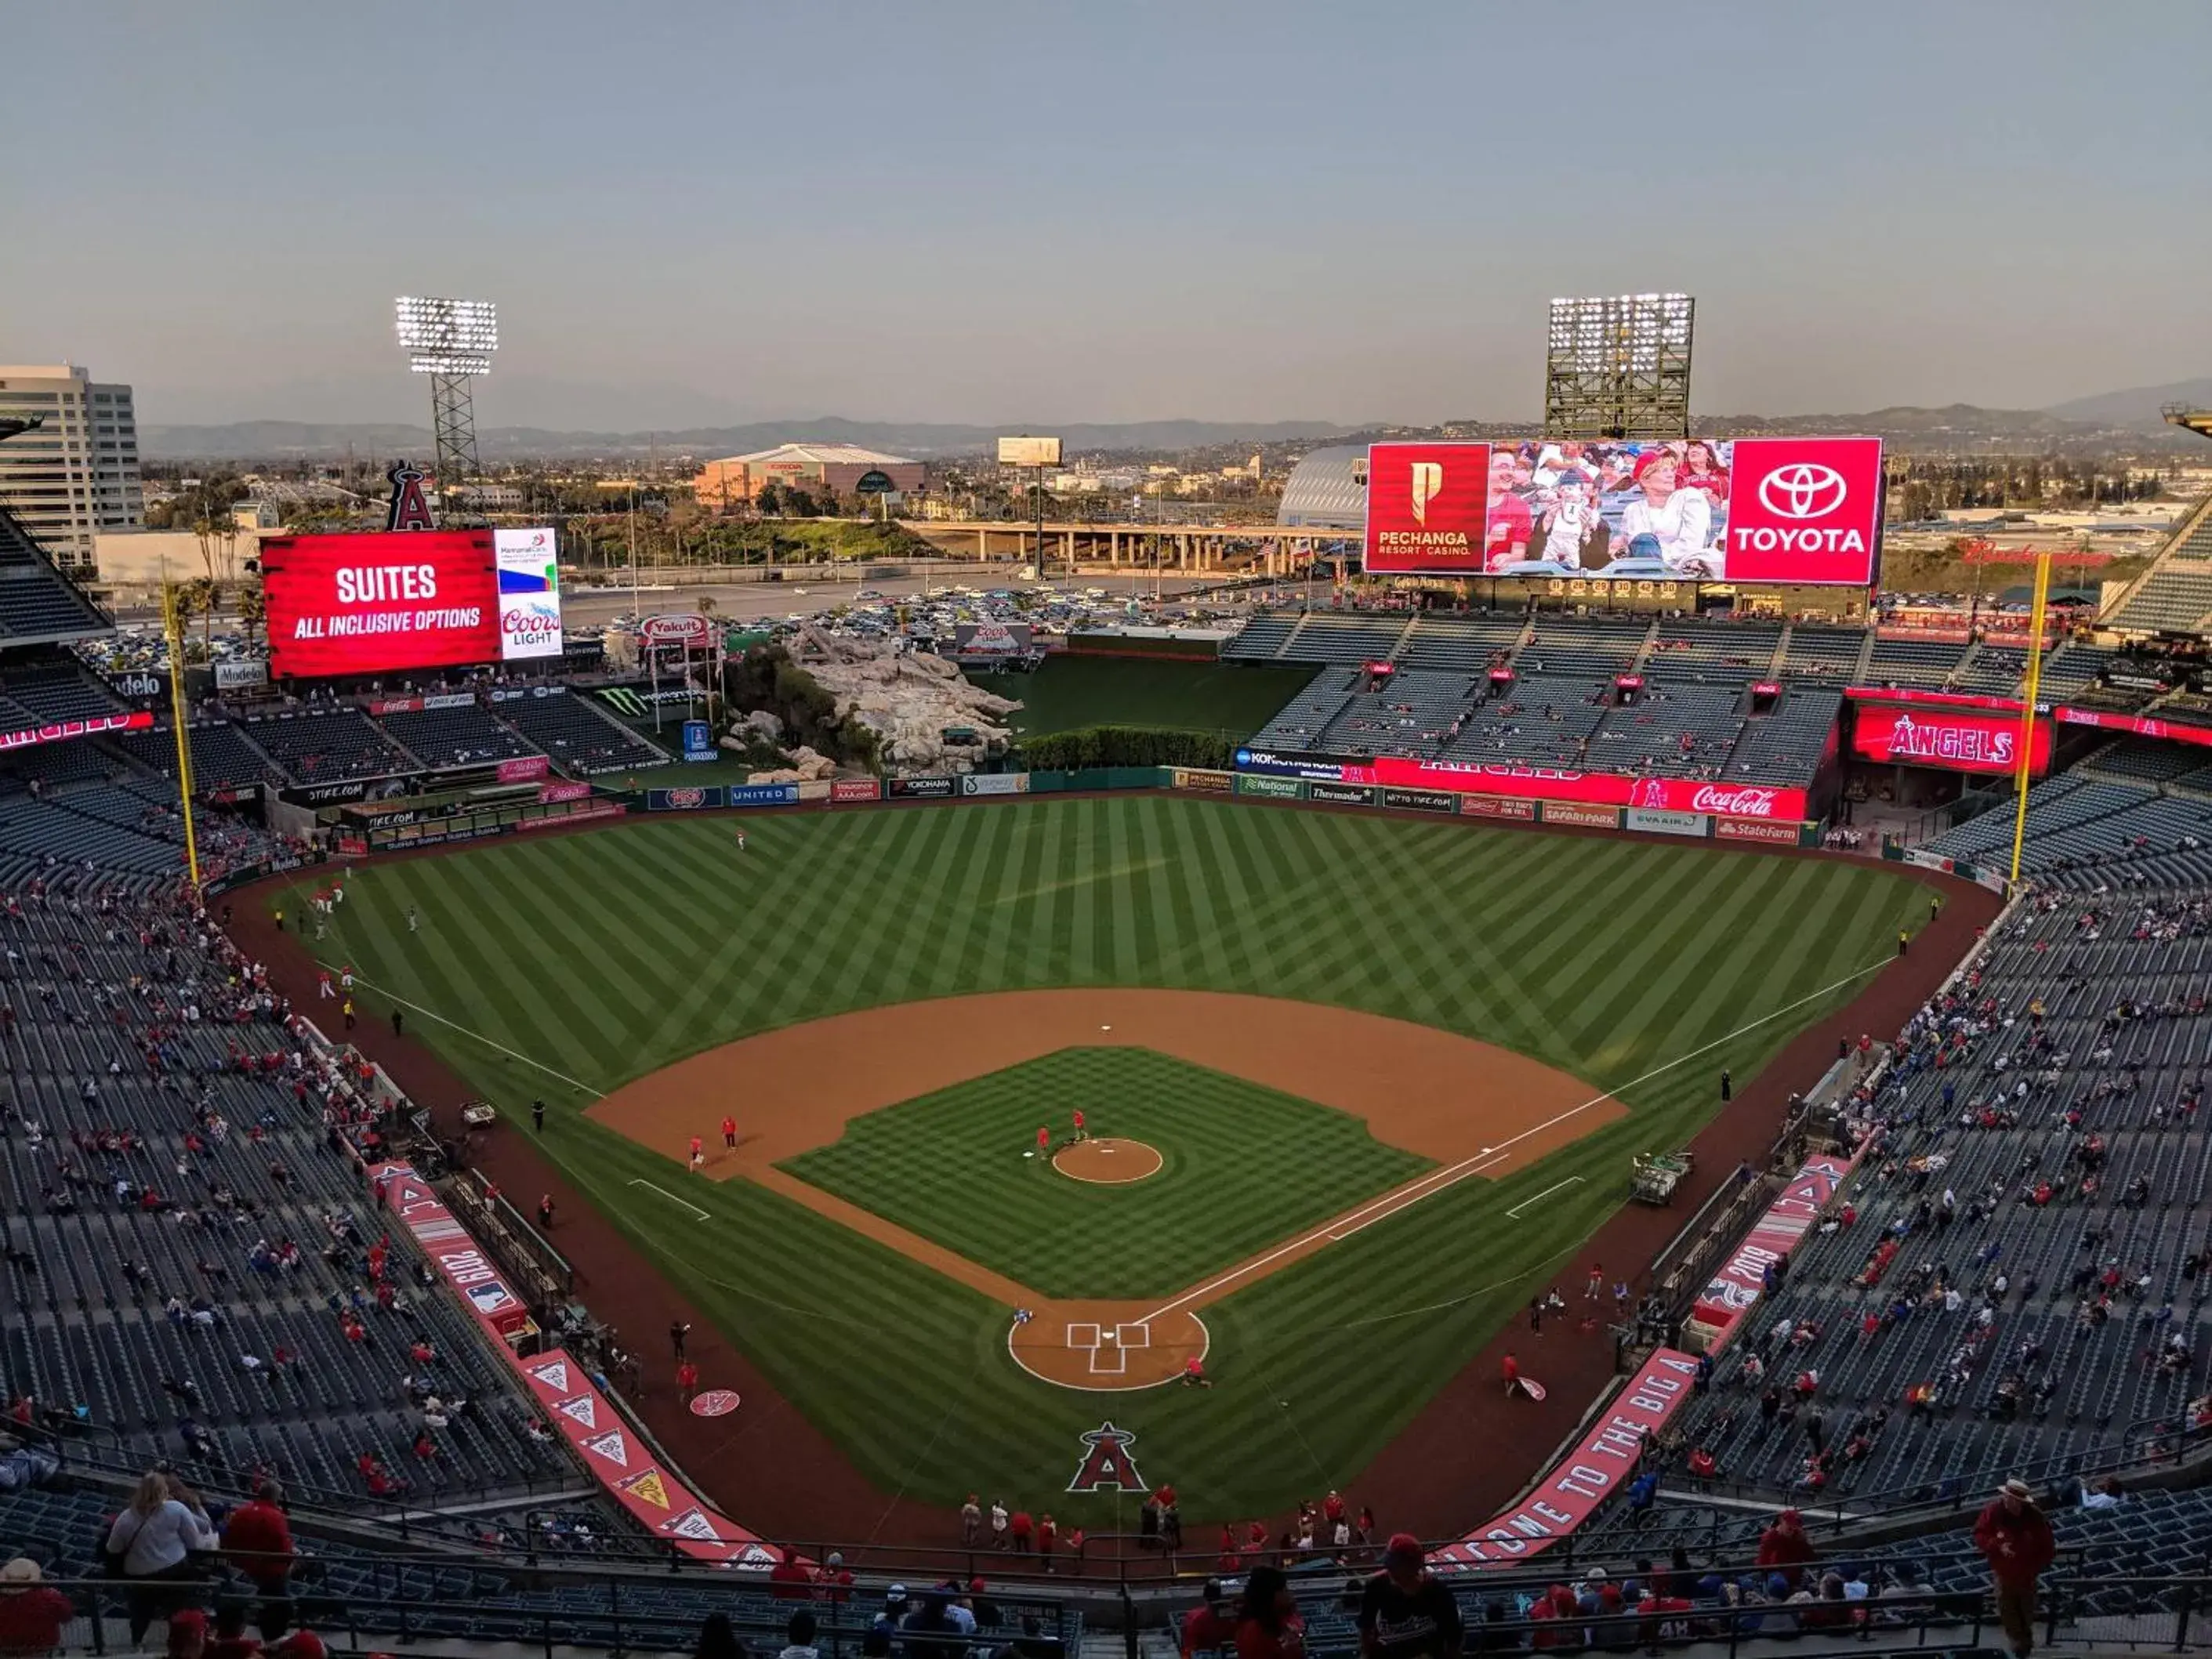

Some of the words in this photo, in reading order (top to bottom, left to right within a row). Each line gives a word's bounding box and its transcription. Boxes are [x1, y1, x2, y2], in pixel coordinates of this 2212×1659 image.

[1380, 532, 1467, 545] PECHANGA
[1735, 528, 1865, 552] TOYOTA
[1380, 545, 1421, 554] RESORT
[336, 565, 437, 603] SUITES
[295, 618, 325, 639] ALL
[328, 611, 412, 636] INCLUSIVE
[415, 607, 480, 630] OPTIONS
[502, 609, 559, 633] Coors
[655, 620, 701, 633] Yakult
[514, 632, 552, 645] LIGHT
[222, 668, 262, 683] Modelo
[1887, 714, 2014, 763] ANGELS
[906, 779, 951, 788] YOKOHAMA
[1257, 781, 1297, 791] National
[734, 790, 783, 800] UNITED
[837, 791, 874, 799] AAA.com
[1313, 788, 1362, 801] Thermador
[1547, 810, 1583, 820] SAFARI
[1585, 813, 1615, 824] PARK
[439, 1250, 495, 1283] 2019
[1557, 1465, 1608, 1498] TO
[1591, 1415, 1649, 1458] THE
[1629, 1375, 1681, 1414] BIG
[1659, 1357, 1699, 1375] A
[1064, 1421, 1150, 1492] A
